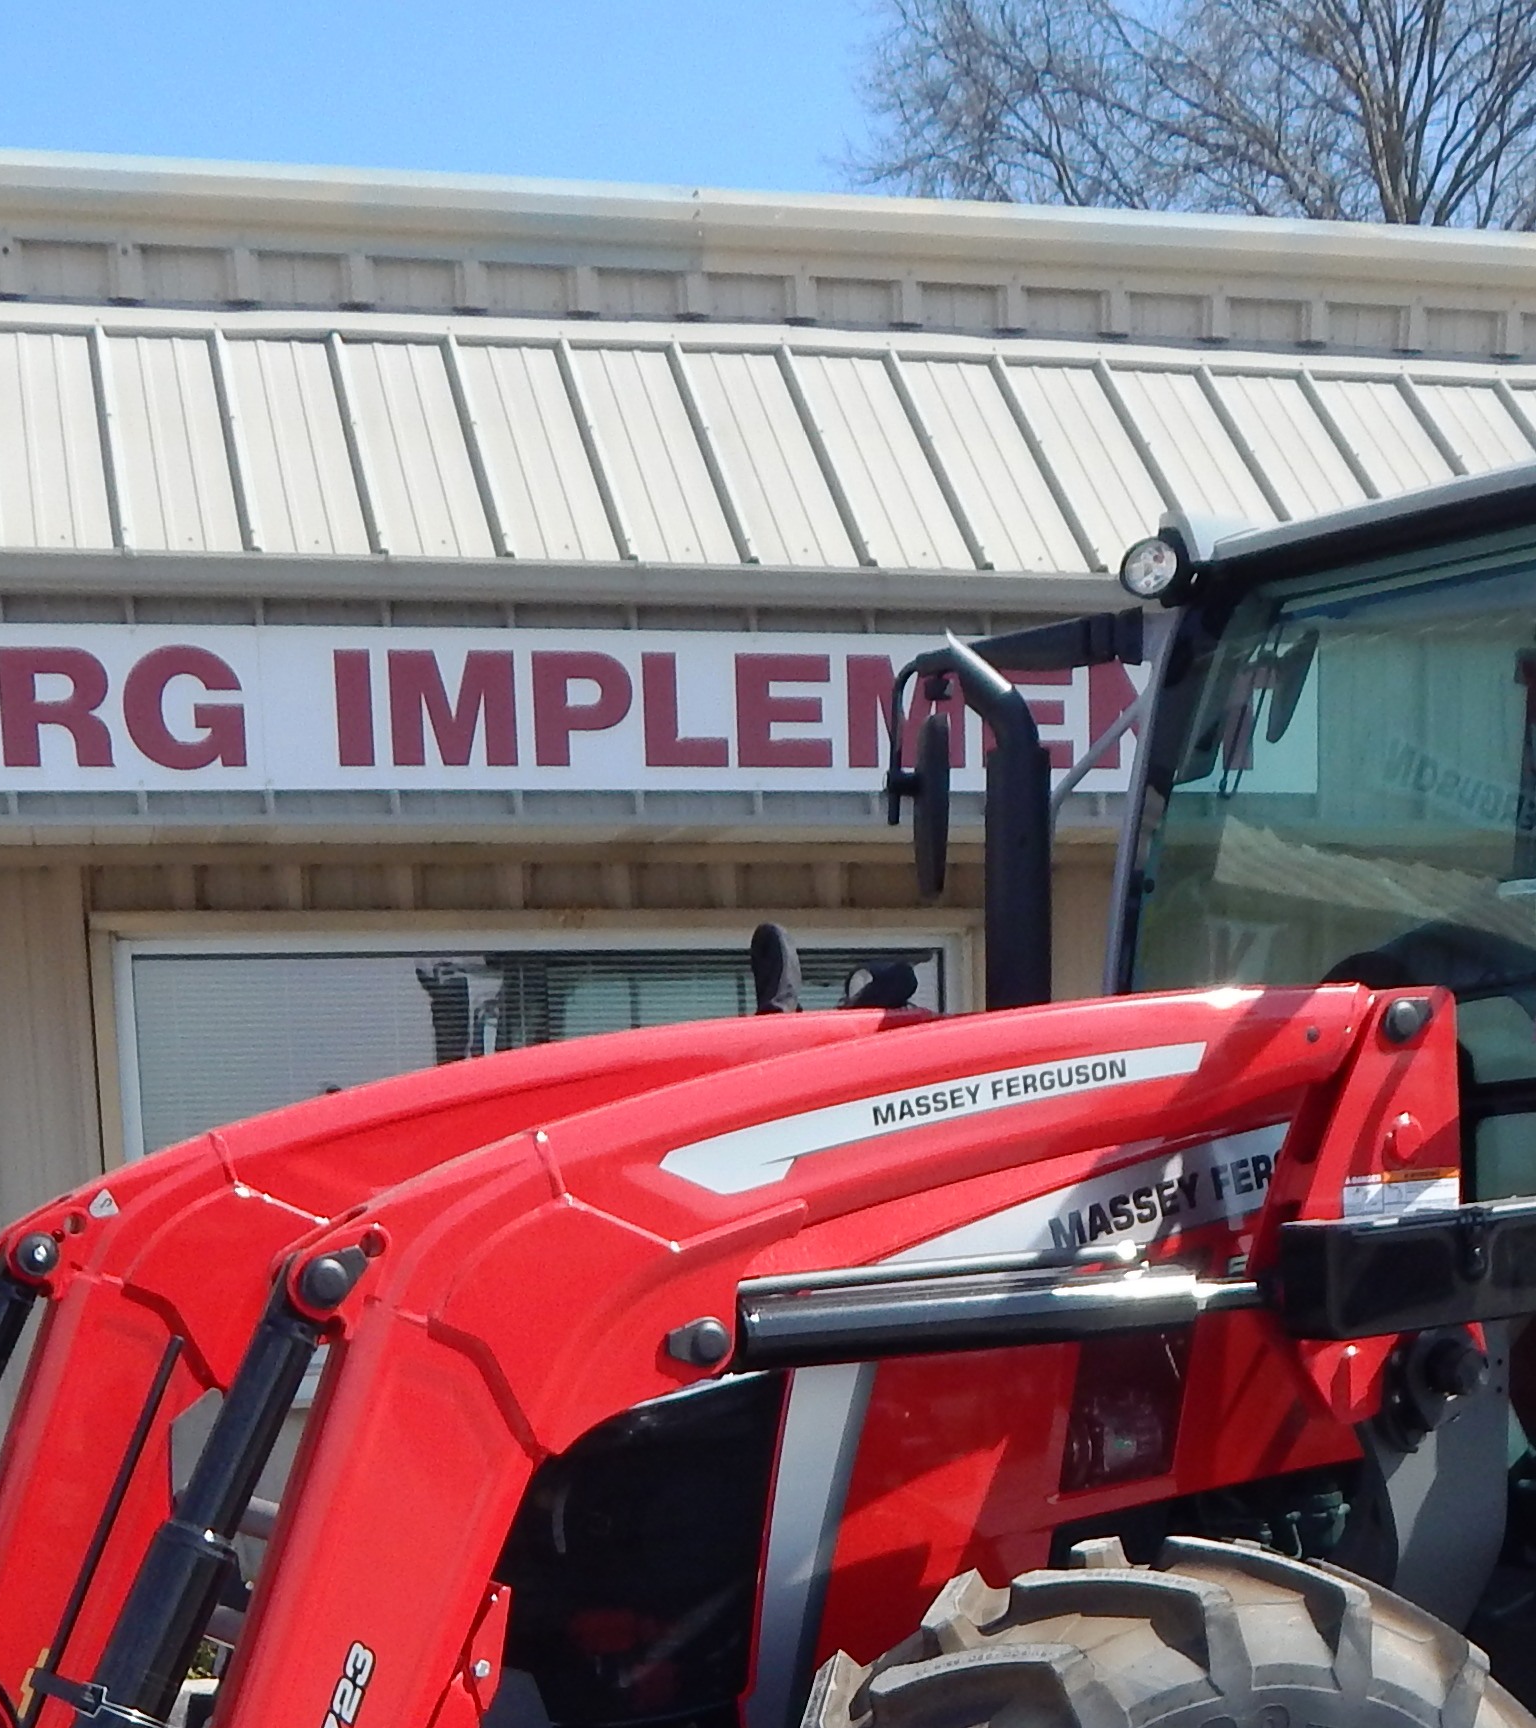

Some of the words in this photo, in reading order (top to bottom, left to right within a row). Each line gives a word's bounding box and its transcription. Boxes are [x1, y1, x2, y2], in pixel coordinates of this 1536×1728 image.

[872, 1084, 981, 1126] MASSEY
[991, 1058, 1127, 1100] FERGUSON
[1048, 1172, 1199, 1249] MASSEY
[1210, 1149, 1284, 1201] FER
